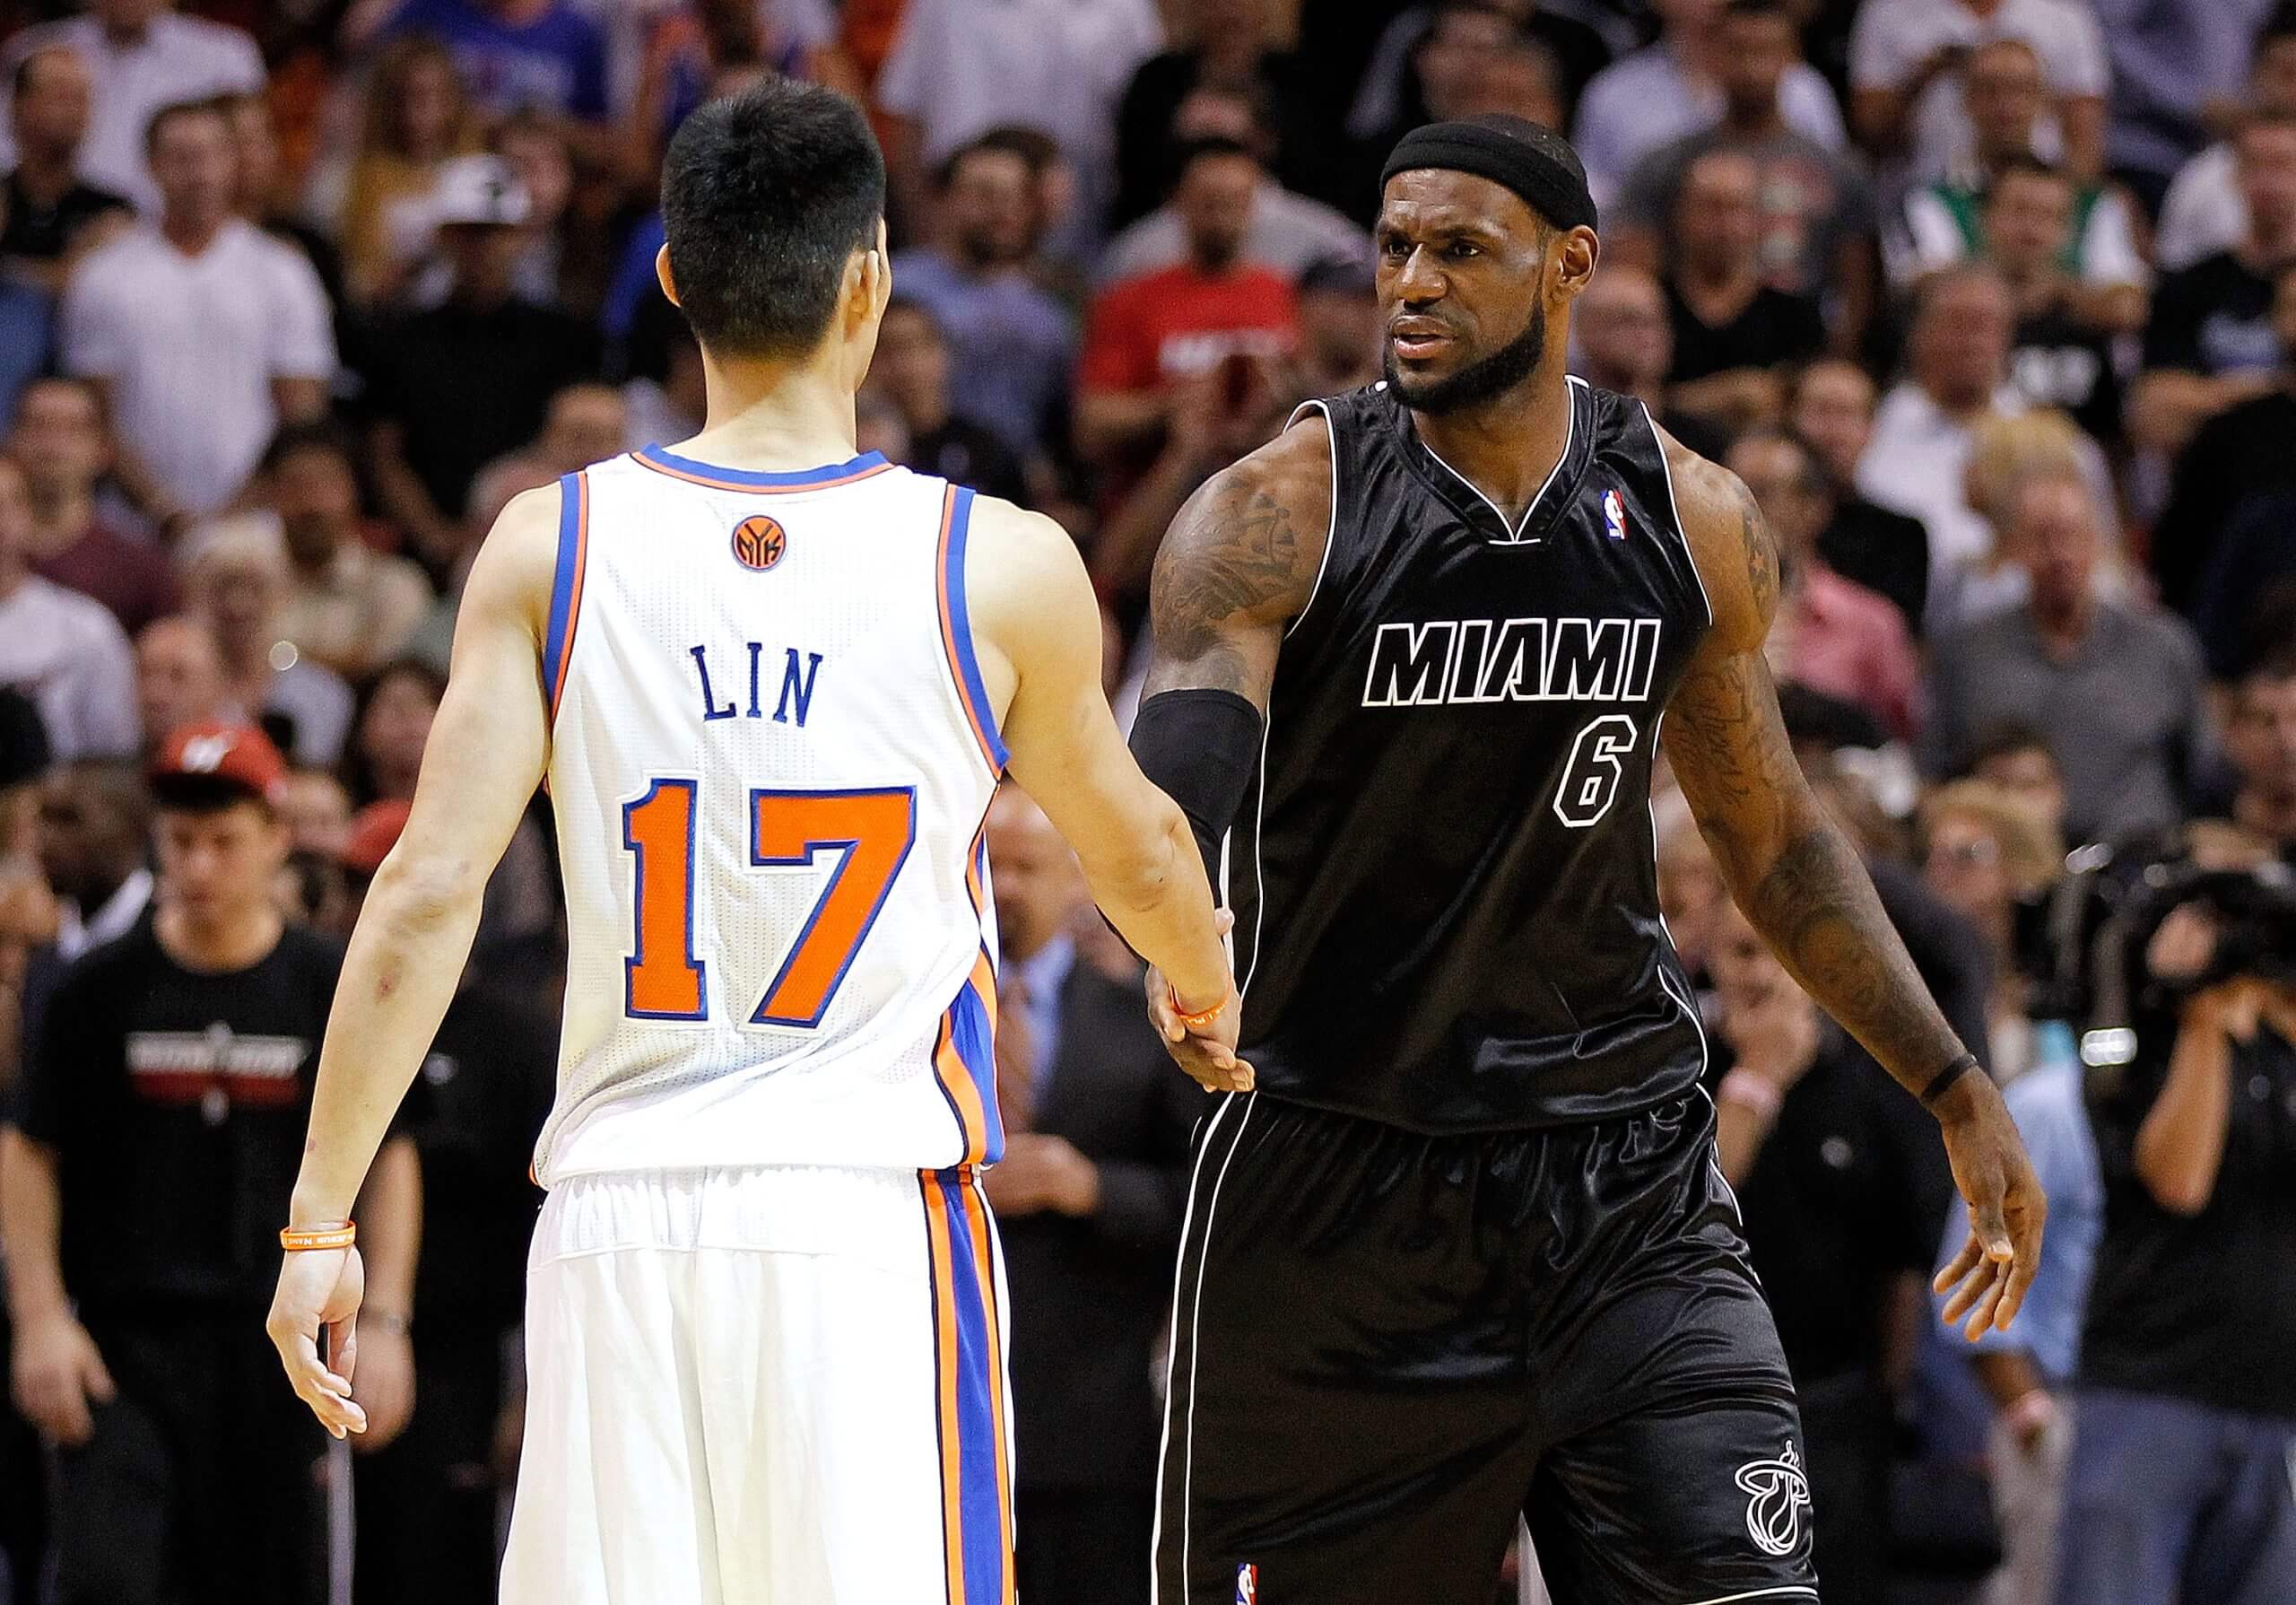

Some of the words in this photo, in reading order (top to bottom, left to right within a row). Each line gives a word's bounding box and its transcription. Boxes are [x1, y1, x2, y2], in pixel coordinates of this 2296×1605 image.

[690, 641, 823, 727] LIN
[1361, 618, 1661, 707] MIAMI
[1552, 714, 1638, 827] 6
[622, 777, 918, 1030] 17
